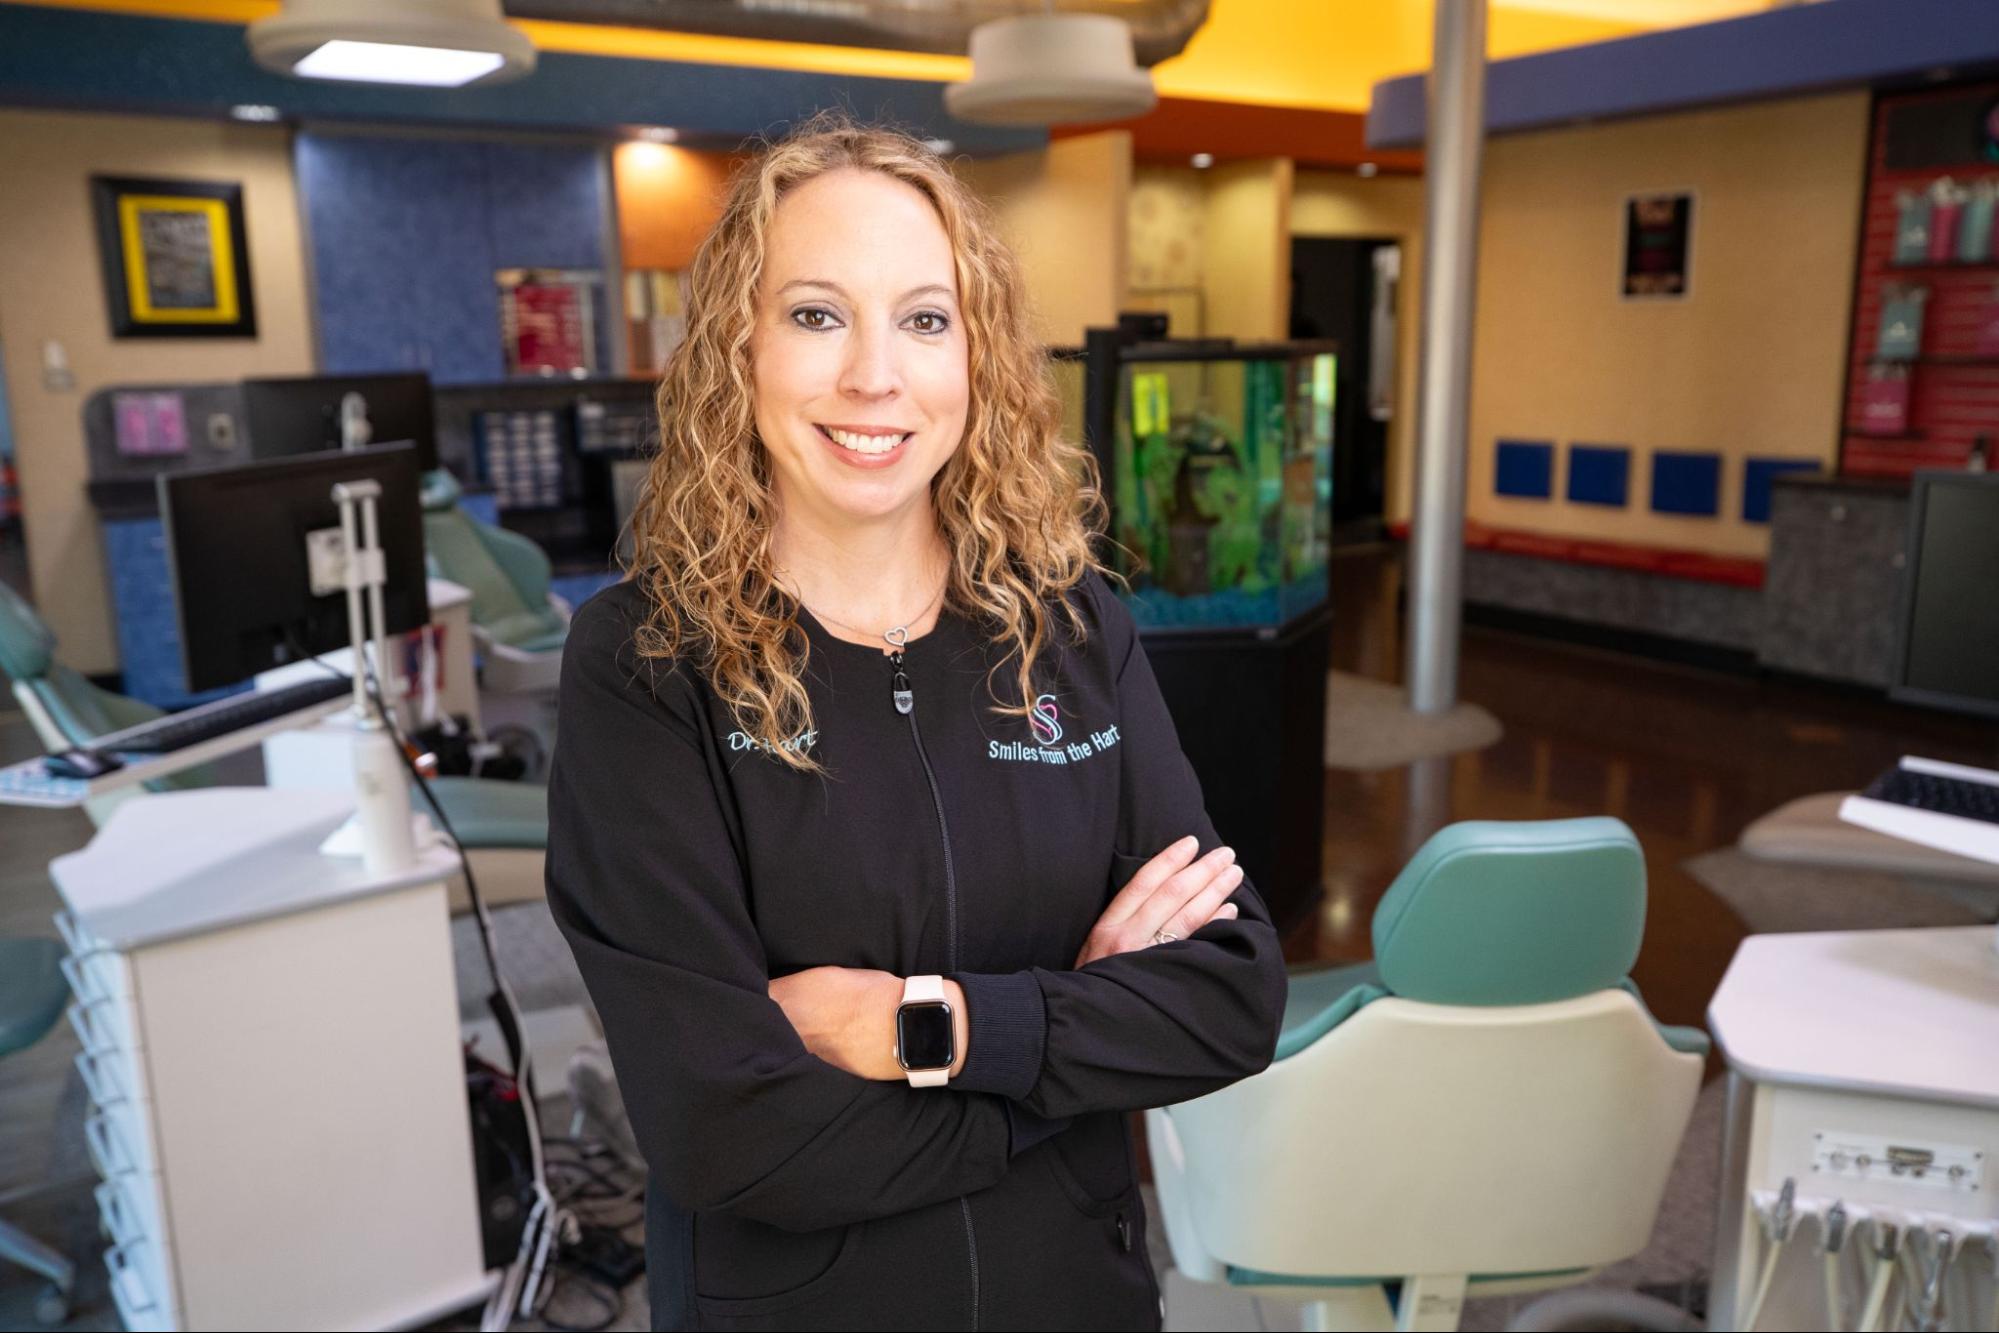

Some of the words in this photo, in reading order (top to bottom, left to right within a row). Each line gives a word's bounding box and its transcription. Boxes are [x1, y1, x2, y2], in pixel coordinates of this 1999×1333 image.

[727, 732, 760, 751] Dr.
[989, 740, 1039, 761] Smiles
[1039, 746, 1068, 765] from
[1067, 742, 1093, 761] the
[1090, 724, 1120, 752] Hart
